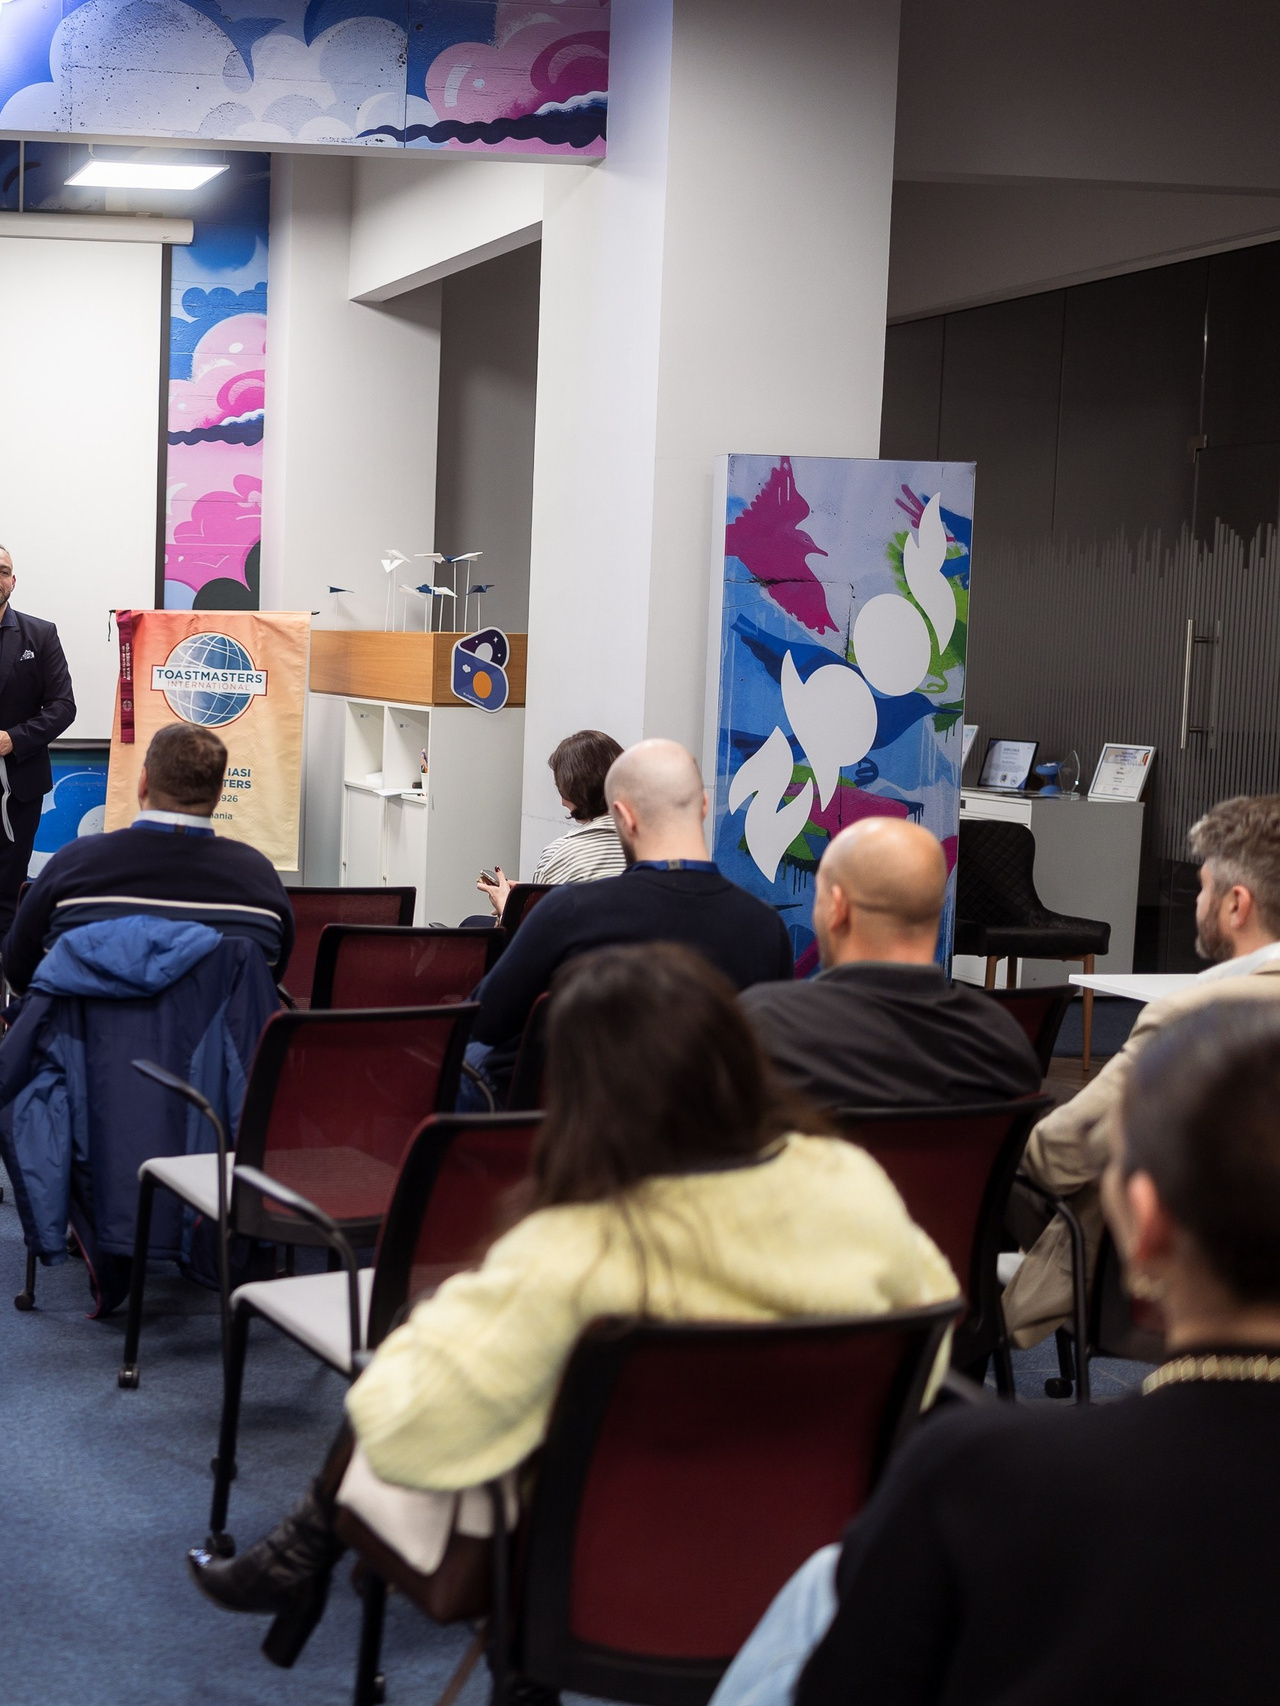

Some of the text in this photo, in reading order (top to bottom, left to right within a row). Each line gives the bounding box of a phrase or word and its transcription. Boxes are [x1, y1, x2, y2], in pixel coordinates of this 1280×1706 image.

[156, 669, 263, 684] TOASTMASTERS
[167, 681, 250, 691] INTERNATIONAL
[227, 768, 251, 777] IASI
[218, 794, 239, 803] 926
